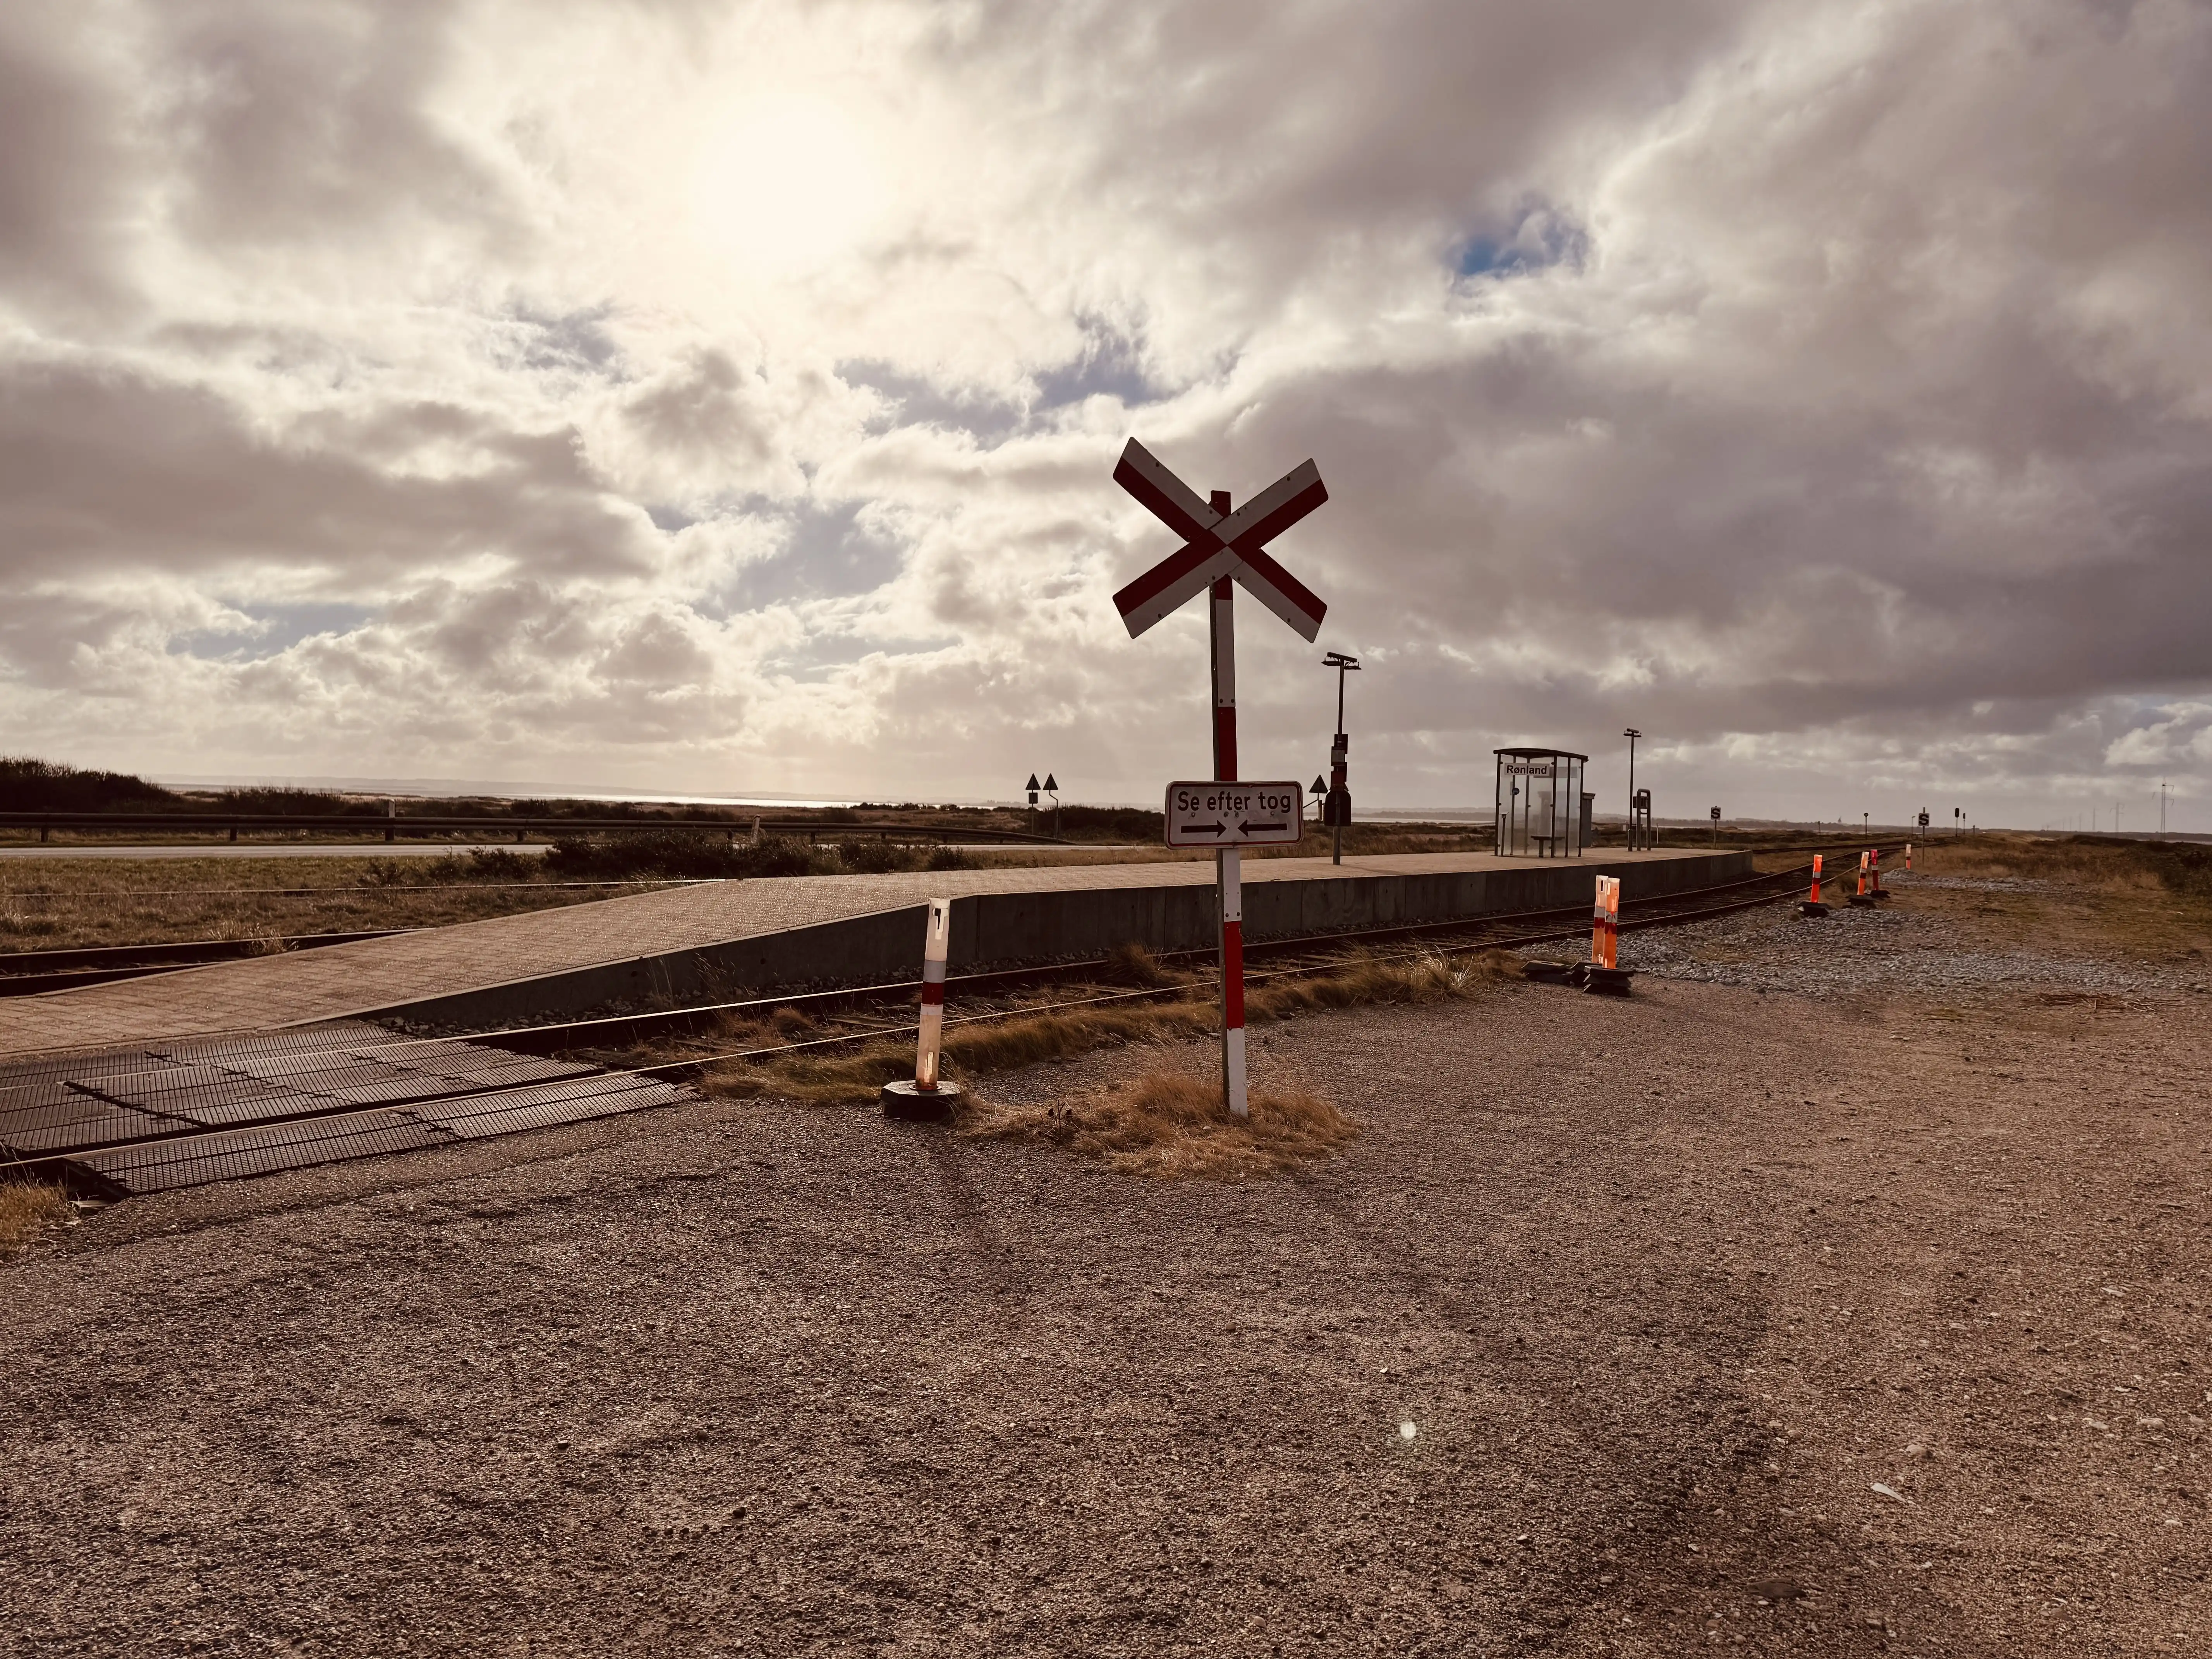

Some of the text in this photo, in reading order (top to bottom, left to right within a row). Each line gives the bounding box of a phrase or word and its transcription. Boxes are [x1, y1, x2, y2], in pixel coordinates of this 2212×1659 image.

[1506, 765, 1547, 774] Rønland
[1177, 791, 1291, 813] Se efter tog
[1711, 808, 1720, 819] S
[1919, 814, 1929, 825] S
